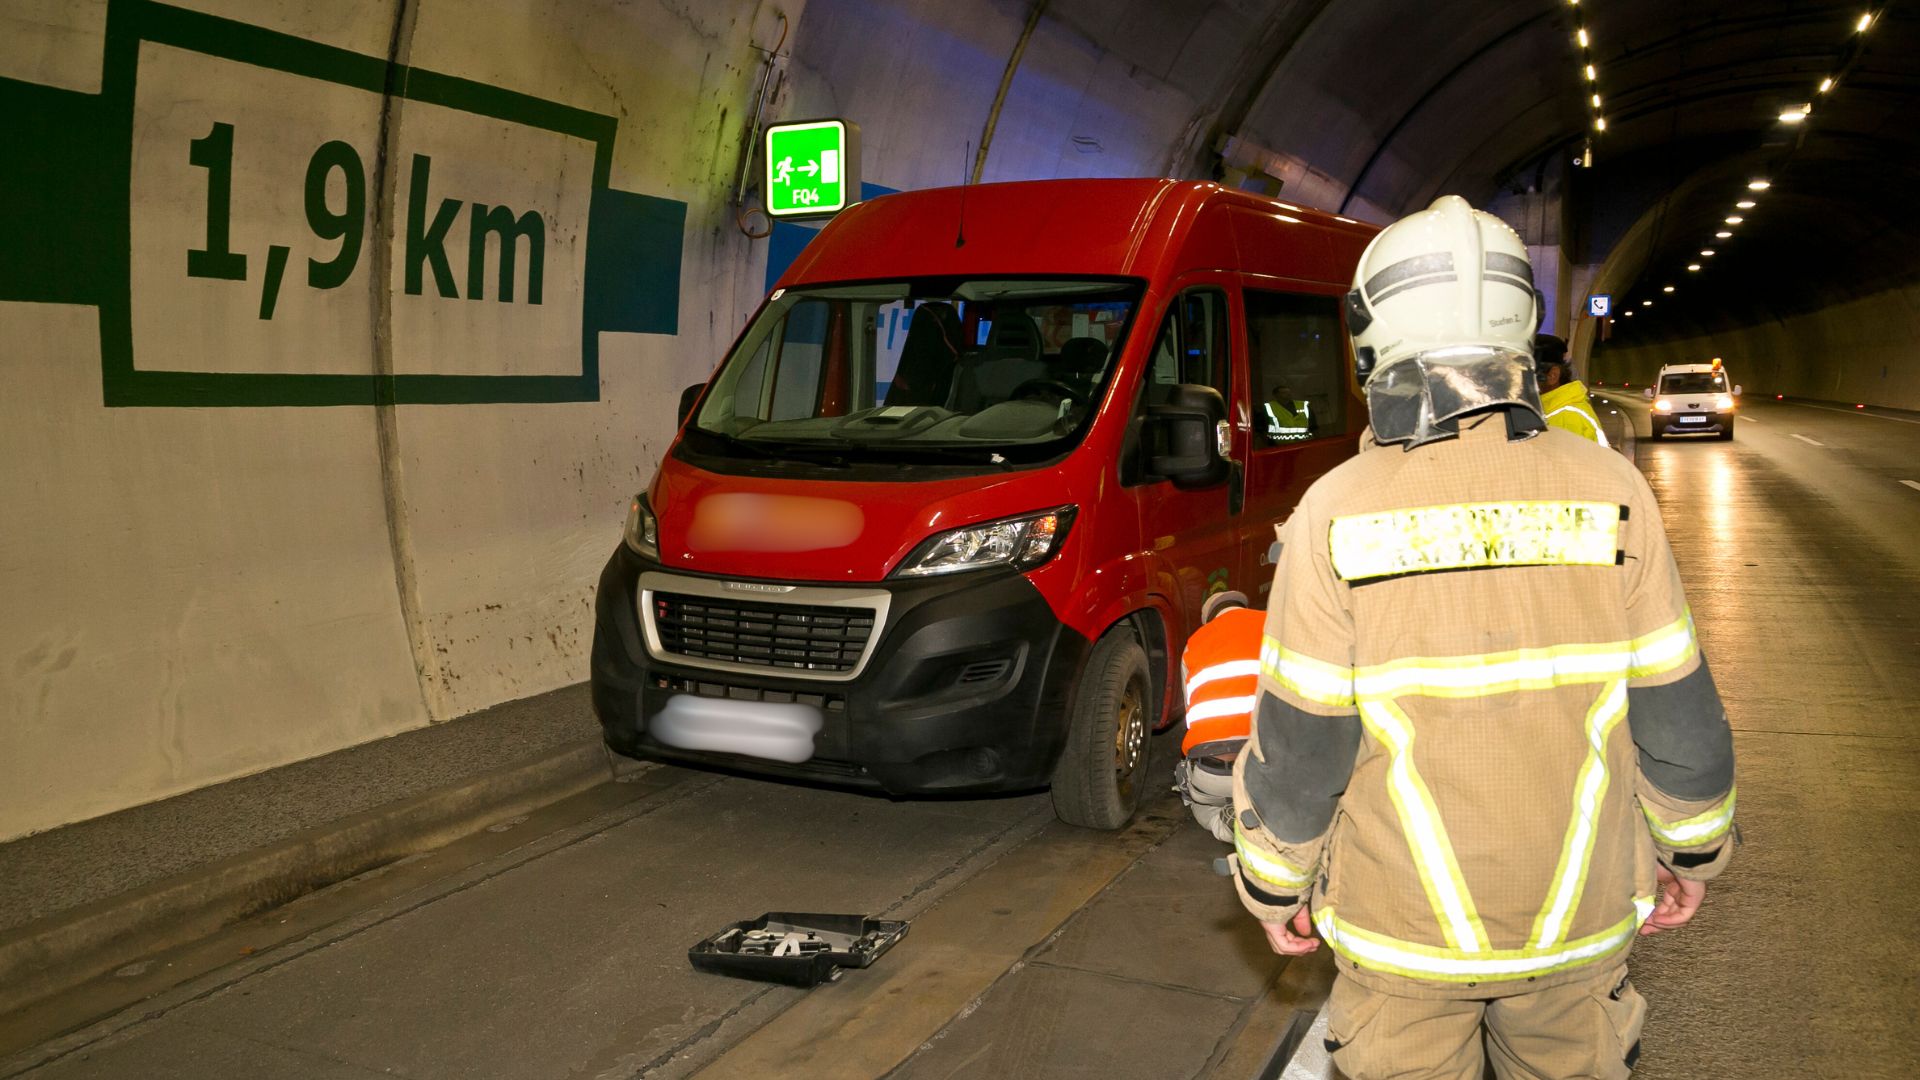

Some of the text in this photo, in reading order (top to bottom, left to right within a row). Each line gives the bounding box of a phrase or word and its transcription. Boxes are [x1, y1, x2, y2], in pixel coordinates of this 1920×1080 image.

[187, 121, 546, 321] 1,9 km
[792, 188, 820, 205] FQ4
